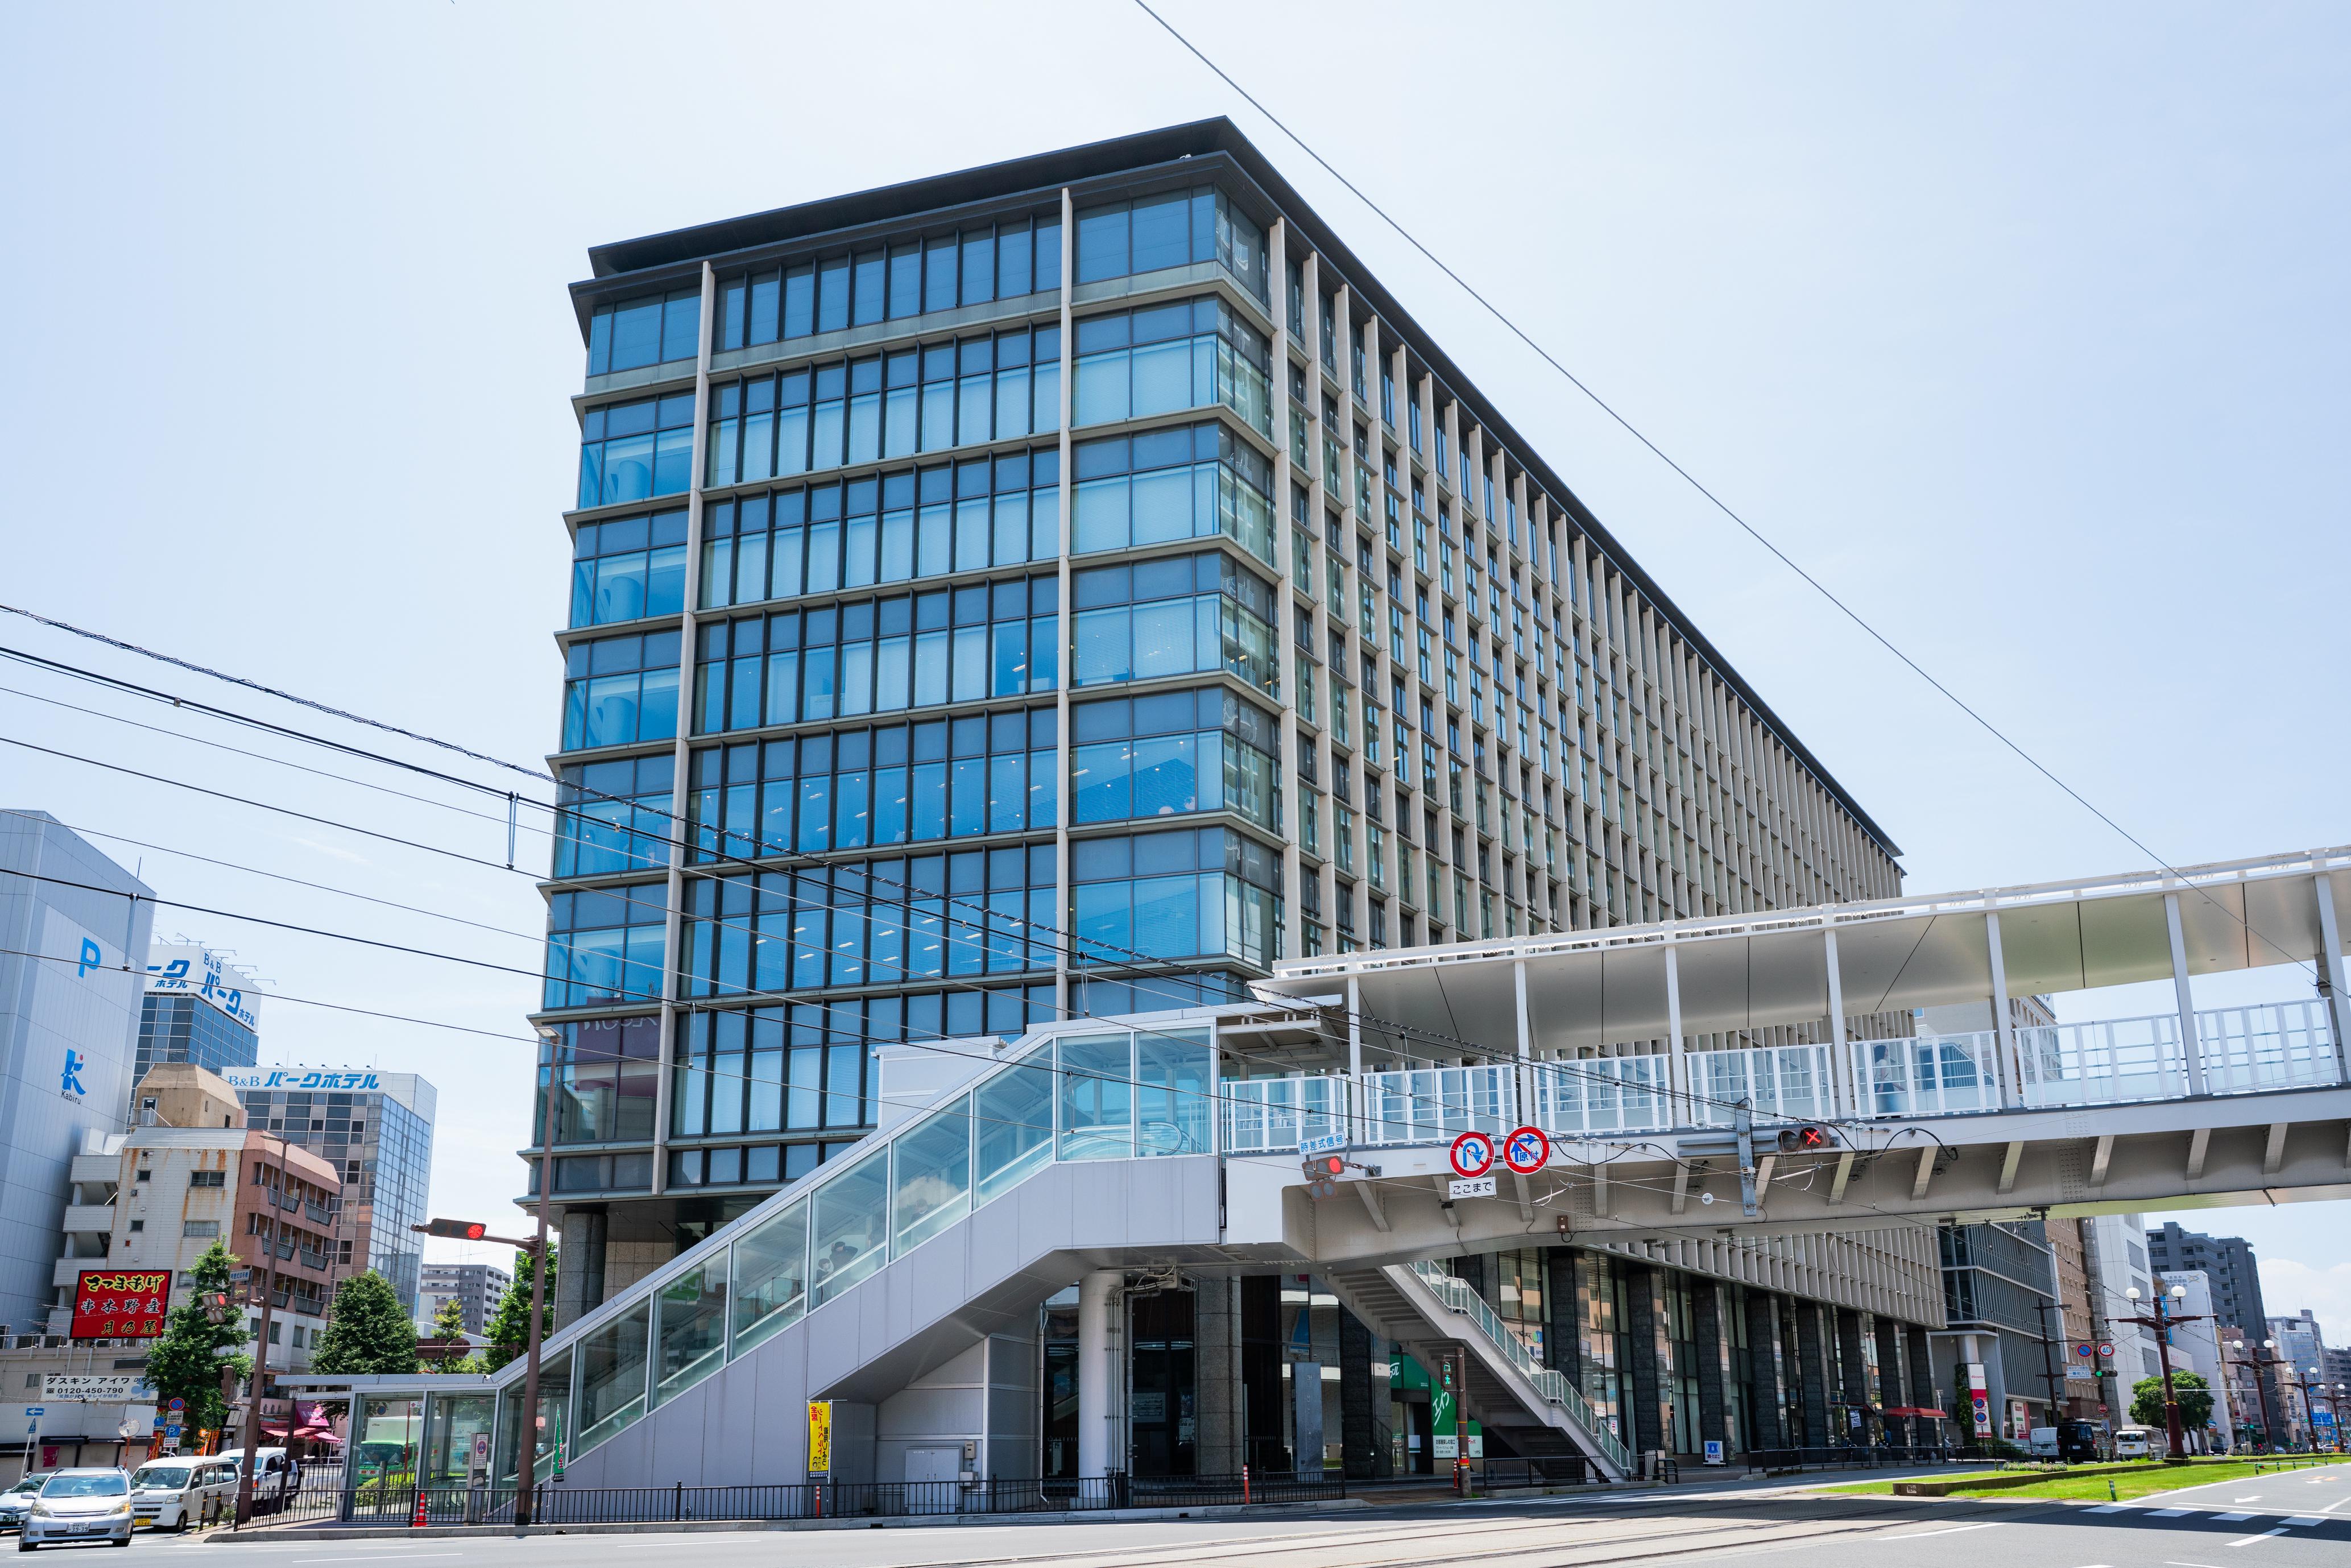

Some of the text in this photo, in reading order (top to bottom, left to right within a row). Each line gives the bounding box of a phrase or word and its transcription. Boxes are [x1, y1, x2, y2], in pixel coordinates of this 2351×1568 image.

[78, 937, 101, 978] P
[204, 953, 221, 974] B&B
[147, 960, 191, 978] ーク
[155, 979, 188, 988] ホテル
[201, 971, 241, 1015] パーク
[238, 1009, 255, 1027] ホテル
[229, 1072, 379, 1089] B&B パークホテル
[61, 1090, 81, 1105] Kabiru
[1301, 1135, 1343, 1152] 時差式信号
[1519, 1151, 1539, 1162] 原付
[1453, 1181, 1492, 1194] ここまで
[85, 1275, 165, 1293] さつまあげ
[81, 1298, 162, 1314] 串木野産
[101, 1320, 157, 1334] 月乃屋
